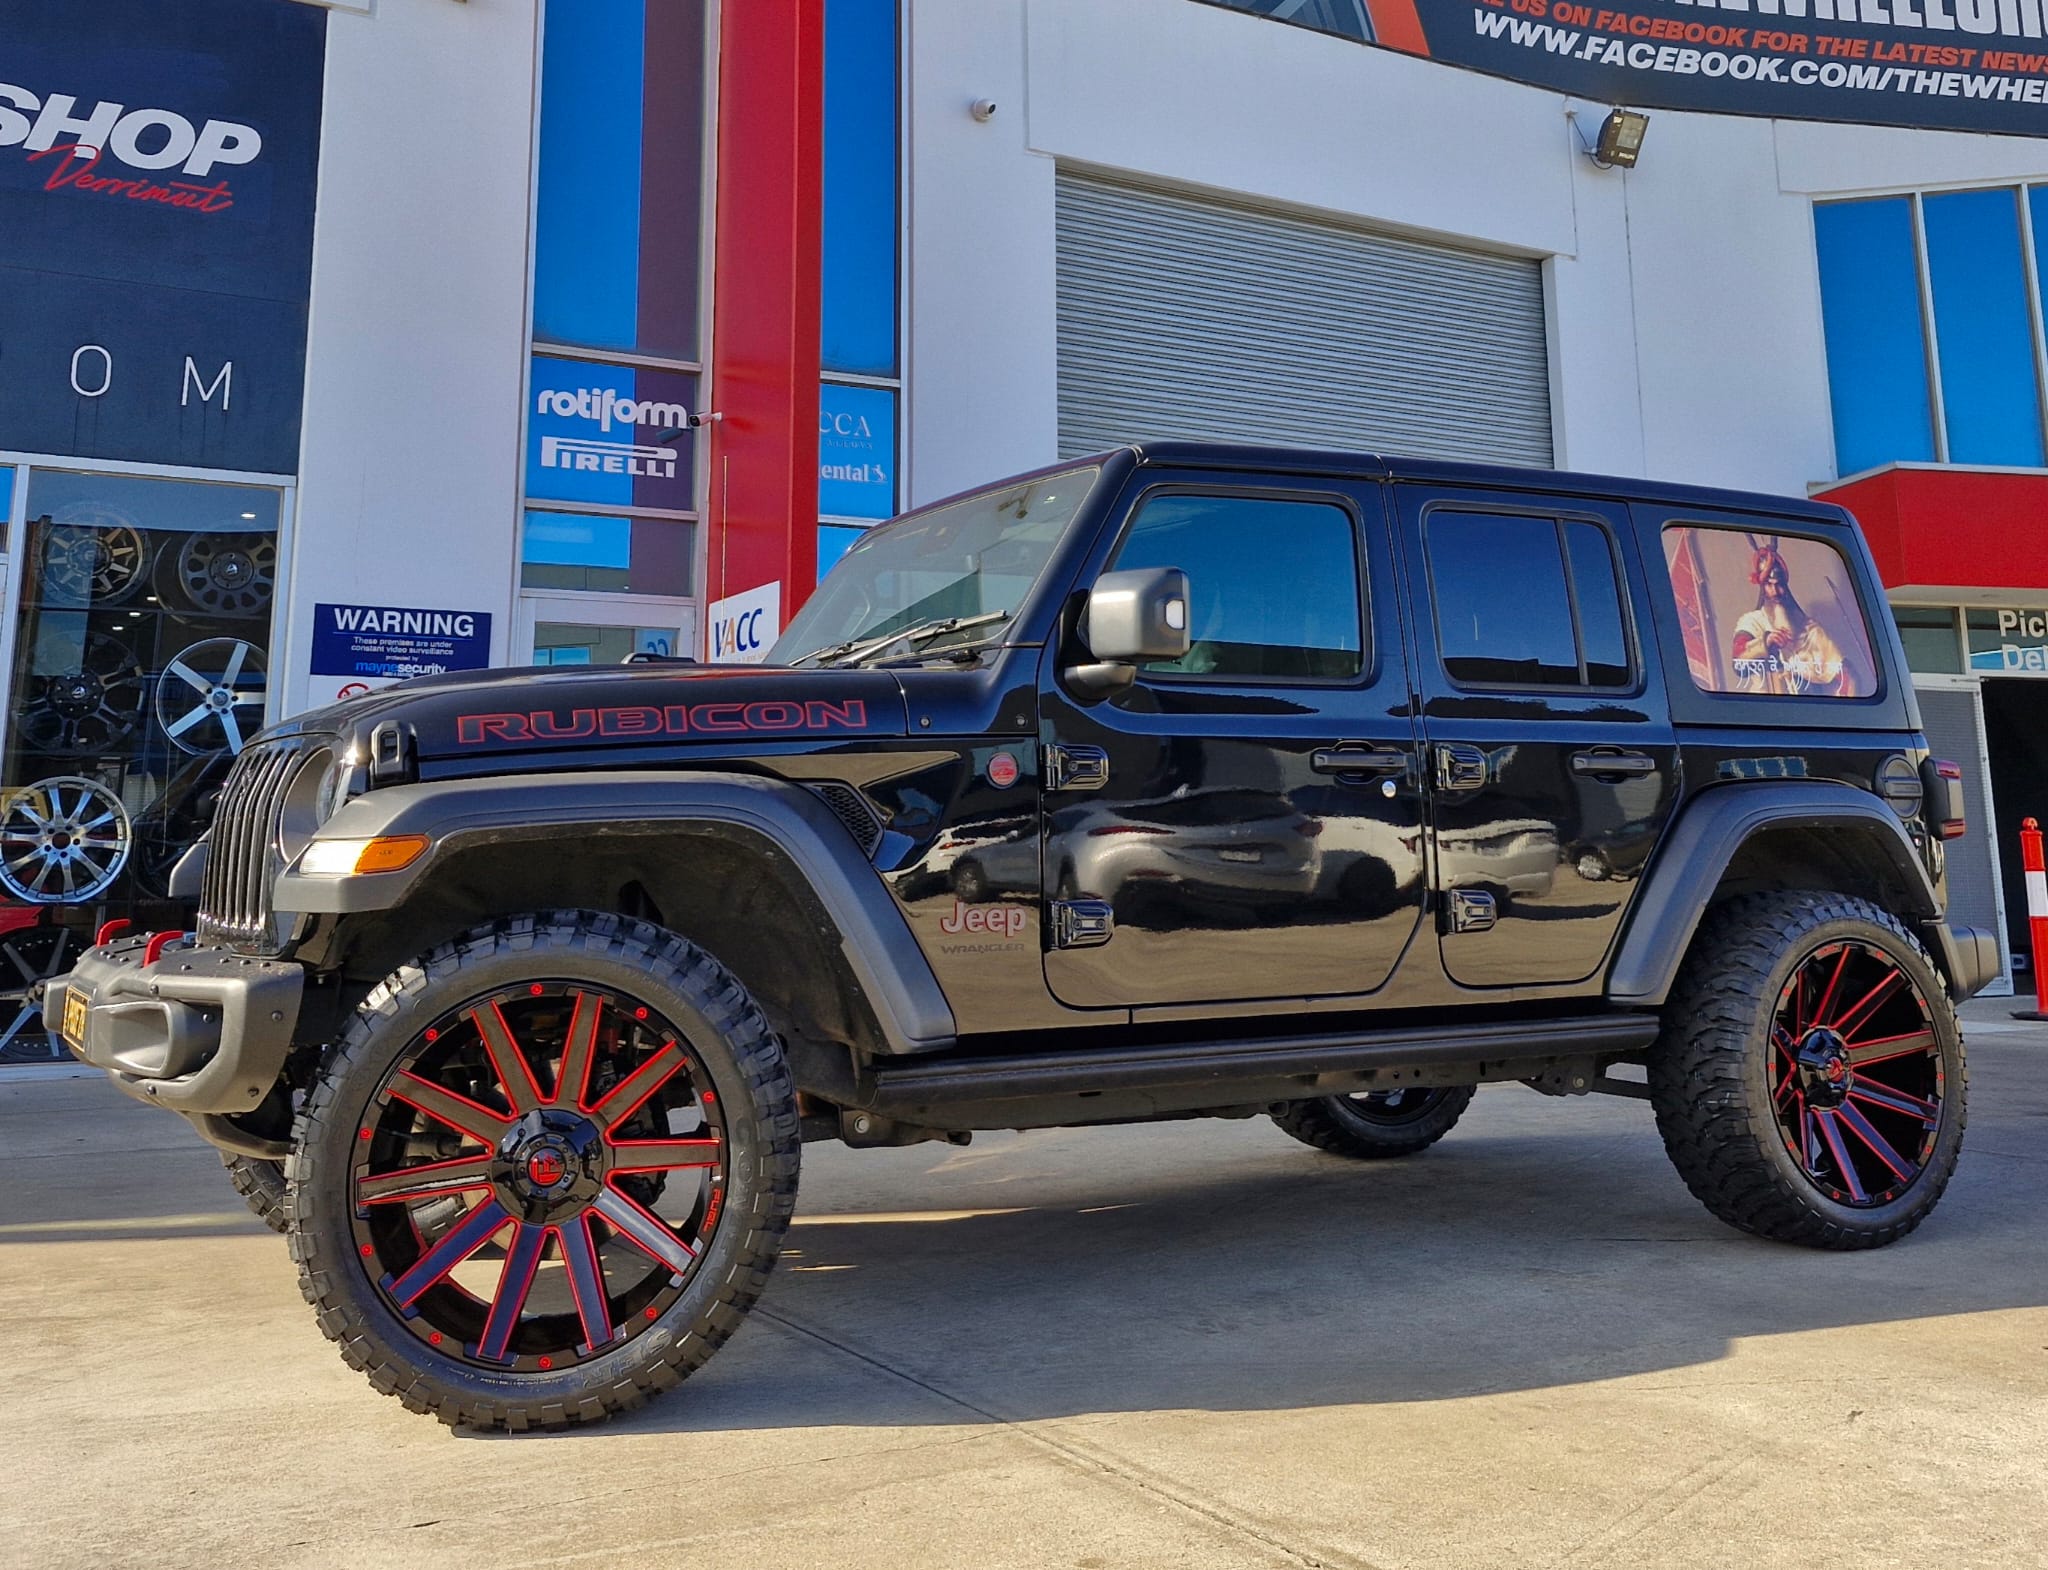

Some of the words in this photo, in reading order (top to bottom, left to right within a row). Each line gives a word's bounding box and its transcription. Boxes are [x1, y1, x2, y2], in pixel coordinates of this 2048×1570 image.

[1511, 0, 1547, 17] US
[1553, 3, 1592, 27] ON
[1594, 10, 1749, 48] FACEBOOK
[1751, 30, 1808, 54] FOR
[1815, 35, 1870, 58] THE
[1872, 40, 1977, 68] LATEST
[1474, 8, 2048, 104] WWW.FACEBOOK.COM/THEWHE
[27, 144, 235, 213] Derrimut
[537, 387, 688, 433] rotiform
[541, 436, 678, 479] PIRELLI
[334, 607, 474, 637] WARNING
[353, 636, 378, 645] These
[379, 639, 414, 648] premises
[430, 641, 453, 649] under
[715, 607, 763, 658] VACC
[1998, 609, 2048, 638] Pic
[351, 645, 385, 653] constant
[386, 646, 408, 654] video
[408, 647, 454, 656] surveillance
[457, 699, 867, 744] RUBICON
[940, 898, 1027, 938] Jeep
[940, 943, 1026, 955] WRANGLER
